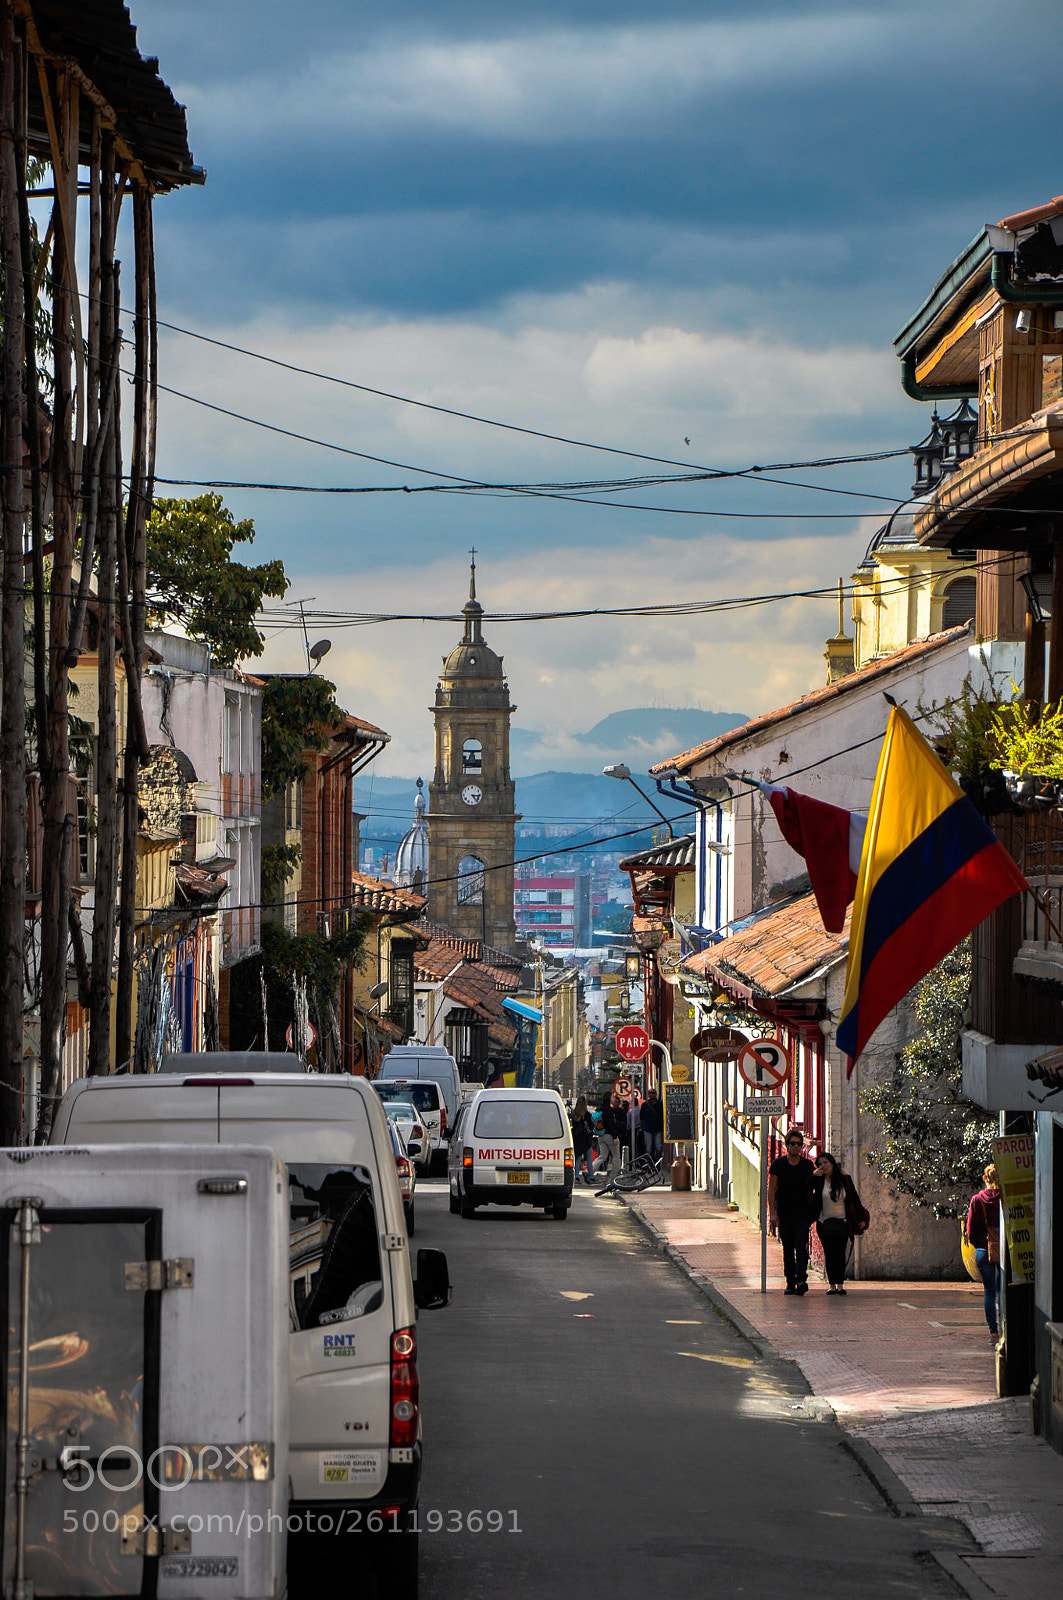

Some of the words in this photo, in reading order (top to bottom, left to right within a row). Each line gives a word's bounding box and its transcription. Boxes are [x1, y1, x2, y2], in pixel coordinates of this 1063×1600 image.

[620, 1037, 645, 1048] PARE
[478, 1149, 560, 1160] MITSUBISHI
[1017, 1251, 1034, 1260] HOR
[323, 1334, 356, 1346] RNT
